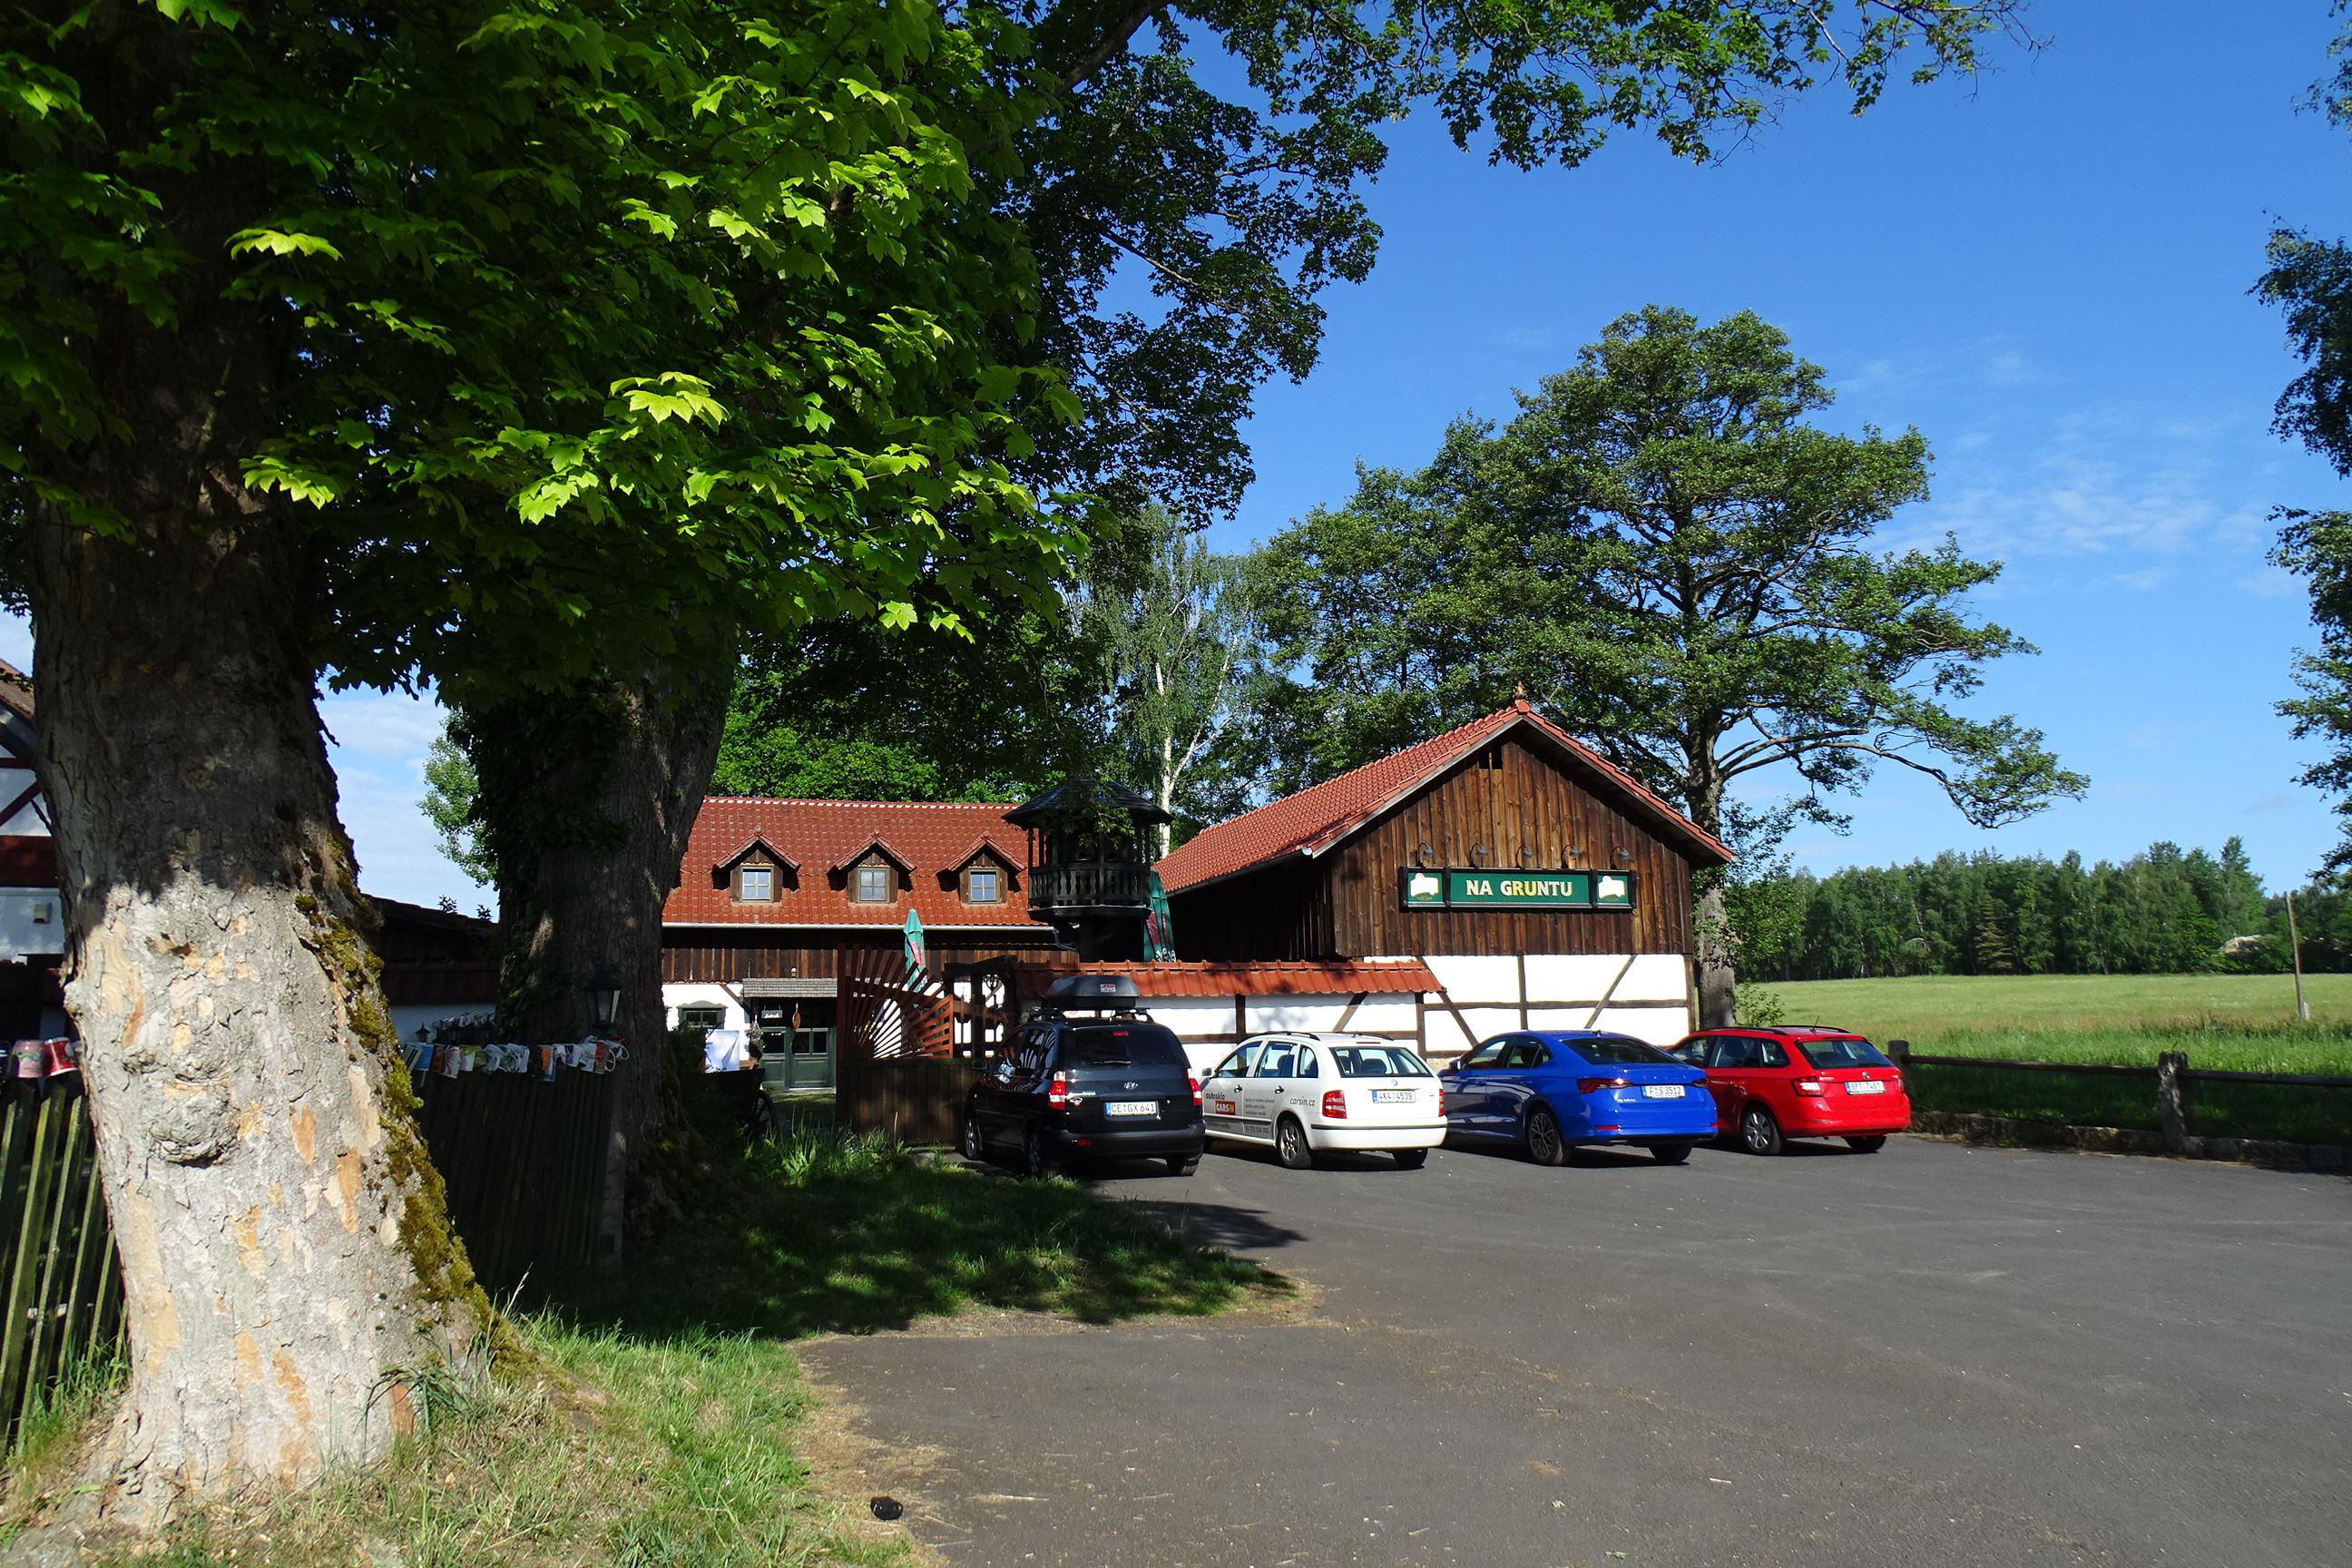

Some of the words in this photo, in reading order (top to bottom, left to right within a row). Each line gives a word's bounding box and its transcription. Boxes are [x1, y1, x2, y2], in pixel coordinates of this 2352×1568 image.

[1465, 880, 1494, 896] NA
[1500, 880, 1573, 897] GRUNTU
[1111, 1103, 1123, 1113] CE
[1127, 1103, 1139, 1113] GX
[1140, 1103, 1155, 1112] 641
